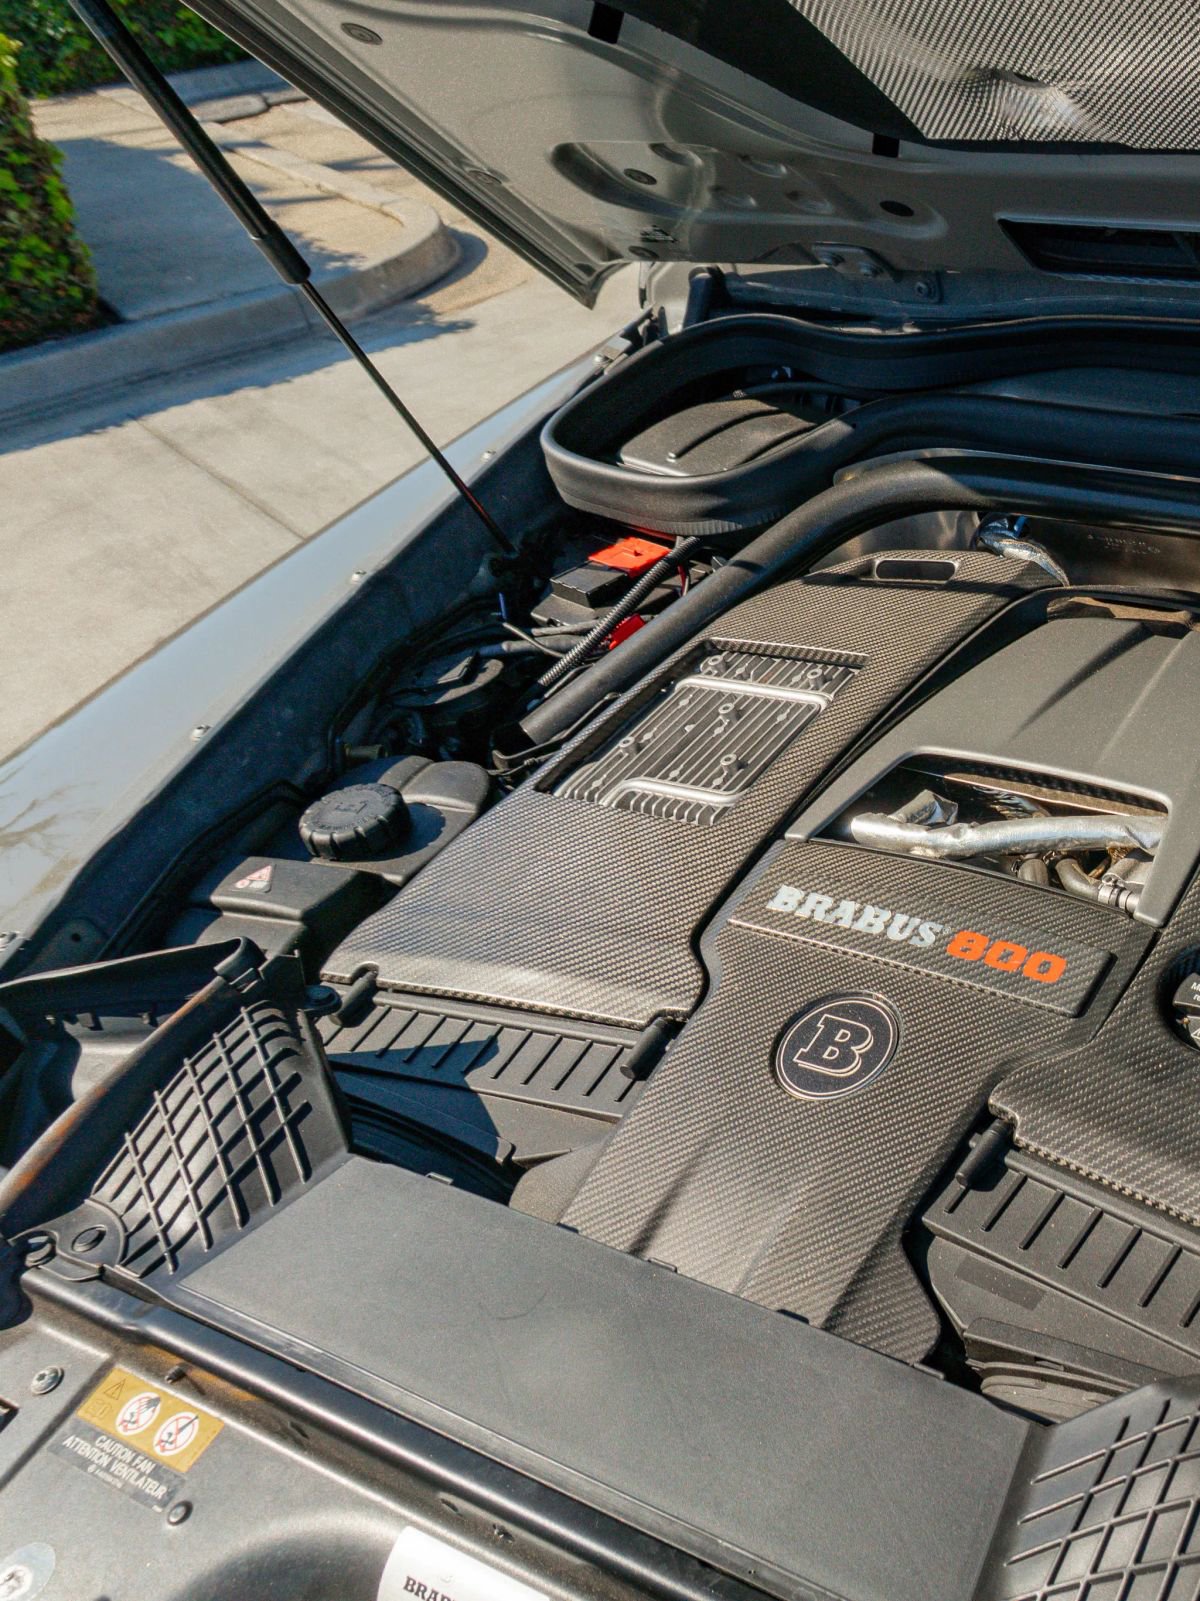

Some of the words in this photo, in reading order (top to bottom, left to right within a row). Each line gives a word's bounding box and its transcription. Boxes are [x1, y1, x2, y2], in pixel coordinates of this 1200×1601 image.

[765, 884, 944, 948] BRABUS
[946, 930, 1068, 984] 800
[793, 1013, 875, 1078] B
[62, 1434, 113, 1469] ATTENTION
[109, 1458, 168, 1500] VENTILATEUR
[95, 1435, 136, 1463] CAUTION
[131, 1455, 156, 1475] FAN
